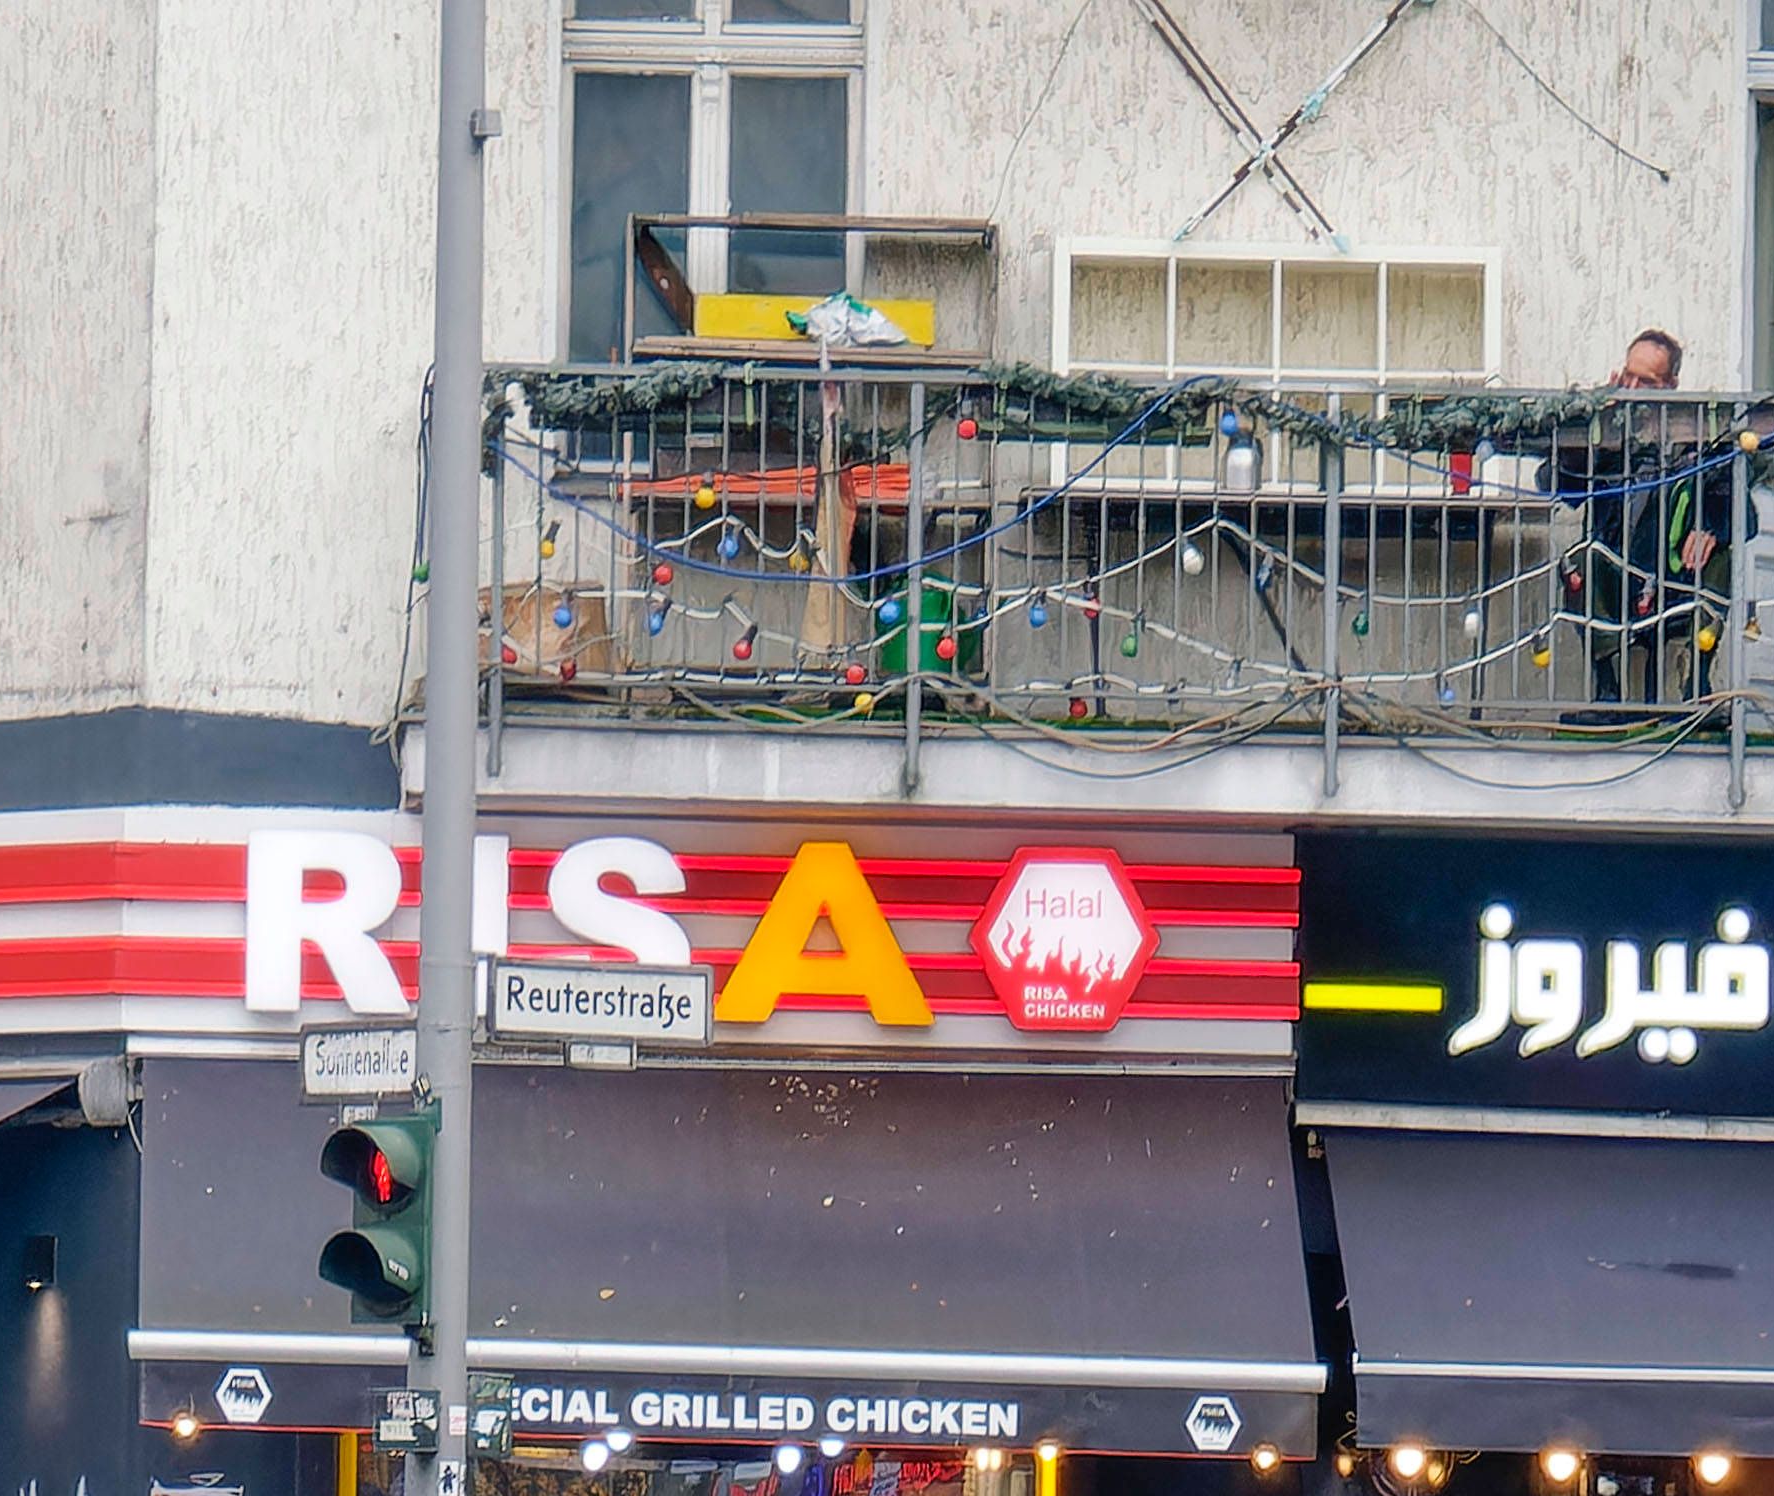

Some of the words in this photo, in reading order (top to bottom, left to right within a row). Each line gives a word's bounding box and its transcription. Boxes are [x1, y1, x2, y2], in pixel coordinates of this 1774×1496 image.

[1024, 887, 1102, 919] Halal
[245, 828, 936, 1028] RISA
[506, 975, 693, 1029] Reuterstraße
[1024, 985, 1068, 1001] RISA
[1446, 902, 1771, 1065] فيروز
[1023, 1003, 1106, 1019] CHICKEN
[630, 1392, 815, 1431] GRILLED
[826, 1398, 1018, 1437] CHICKEN
